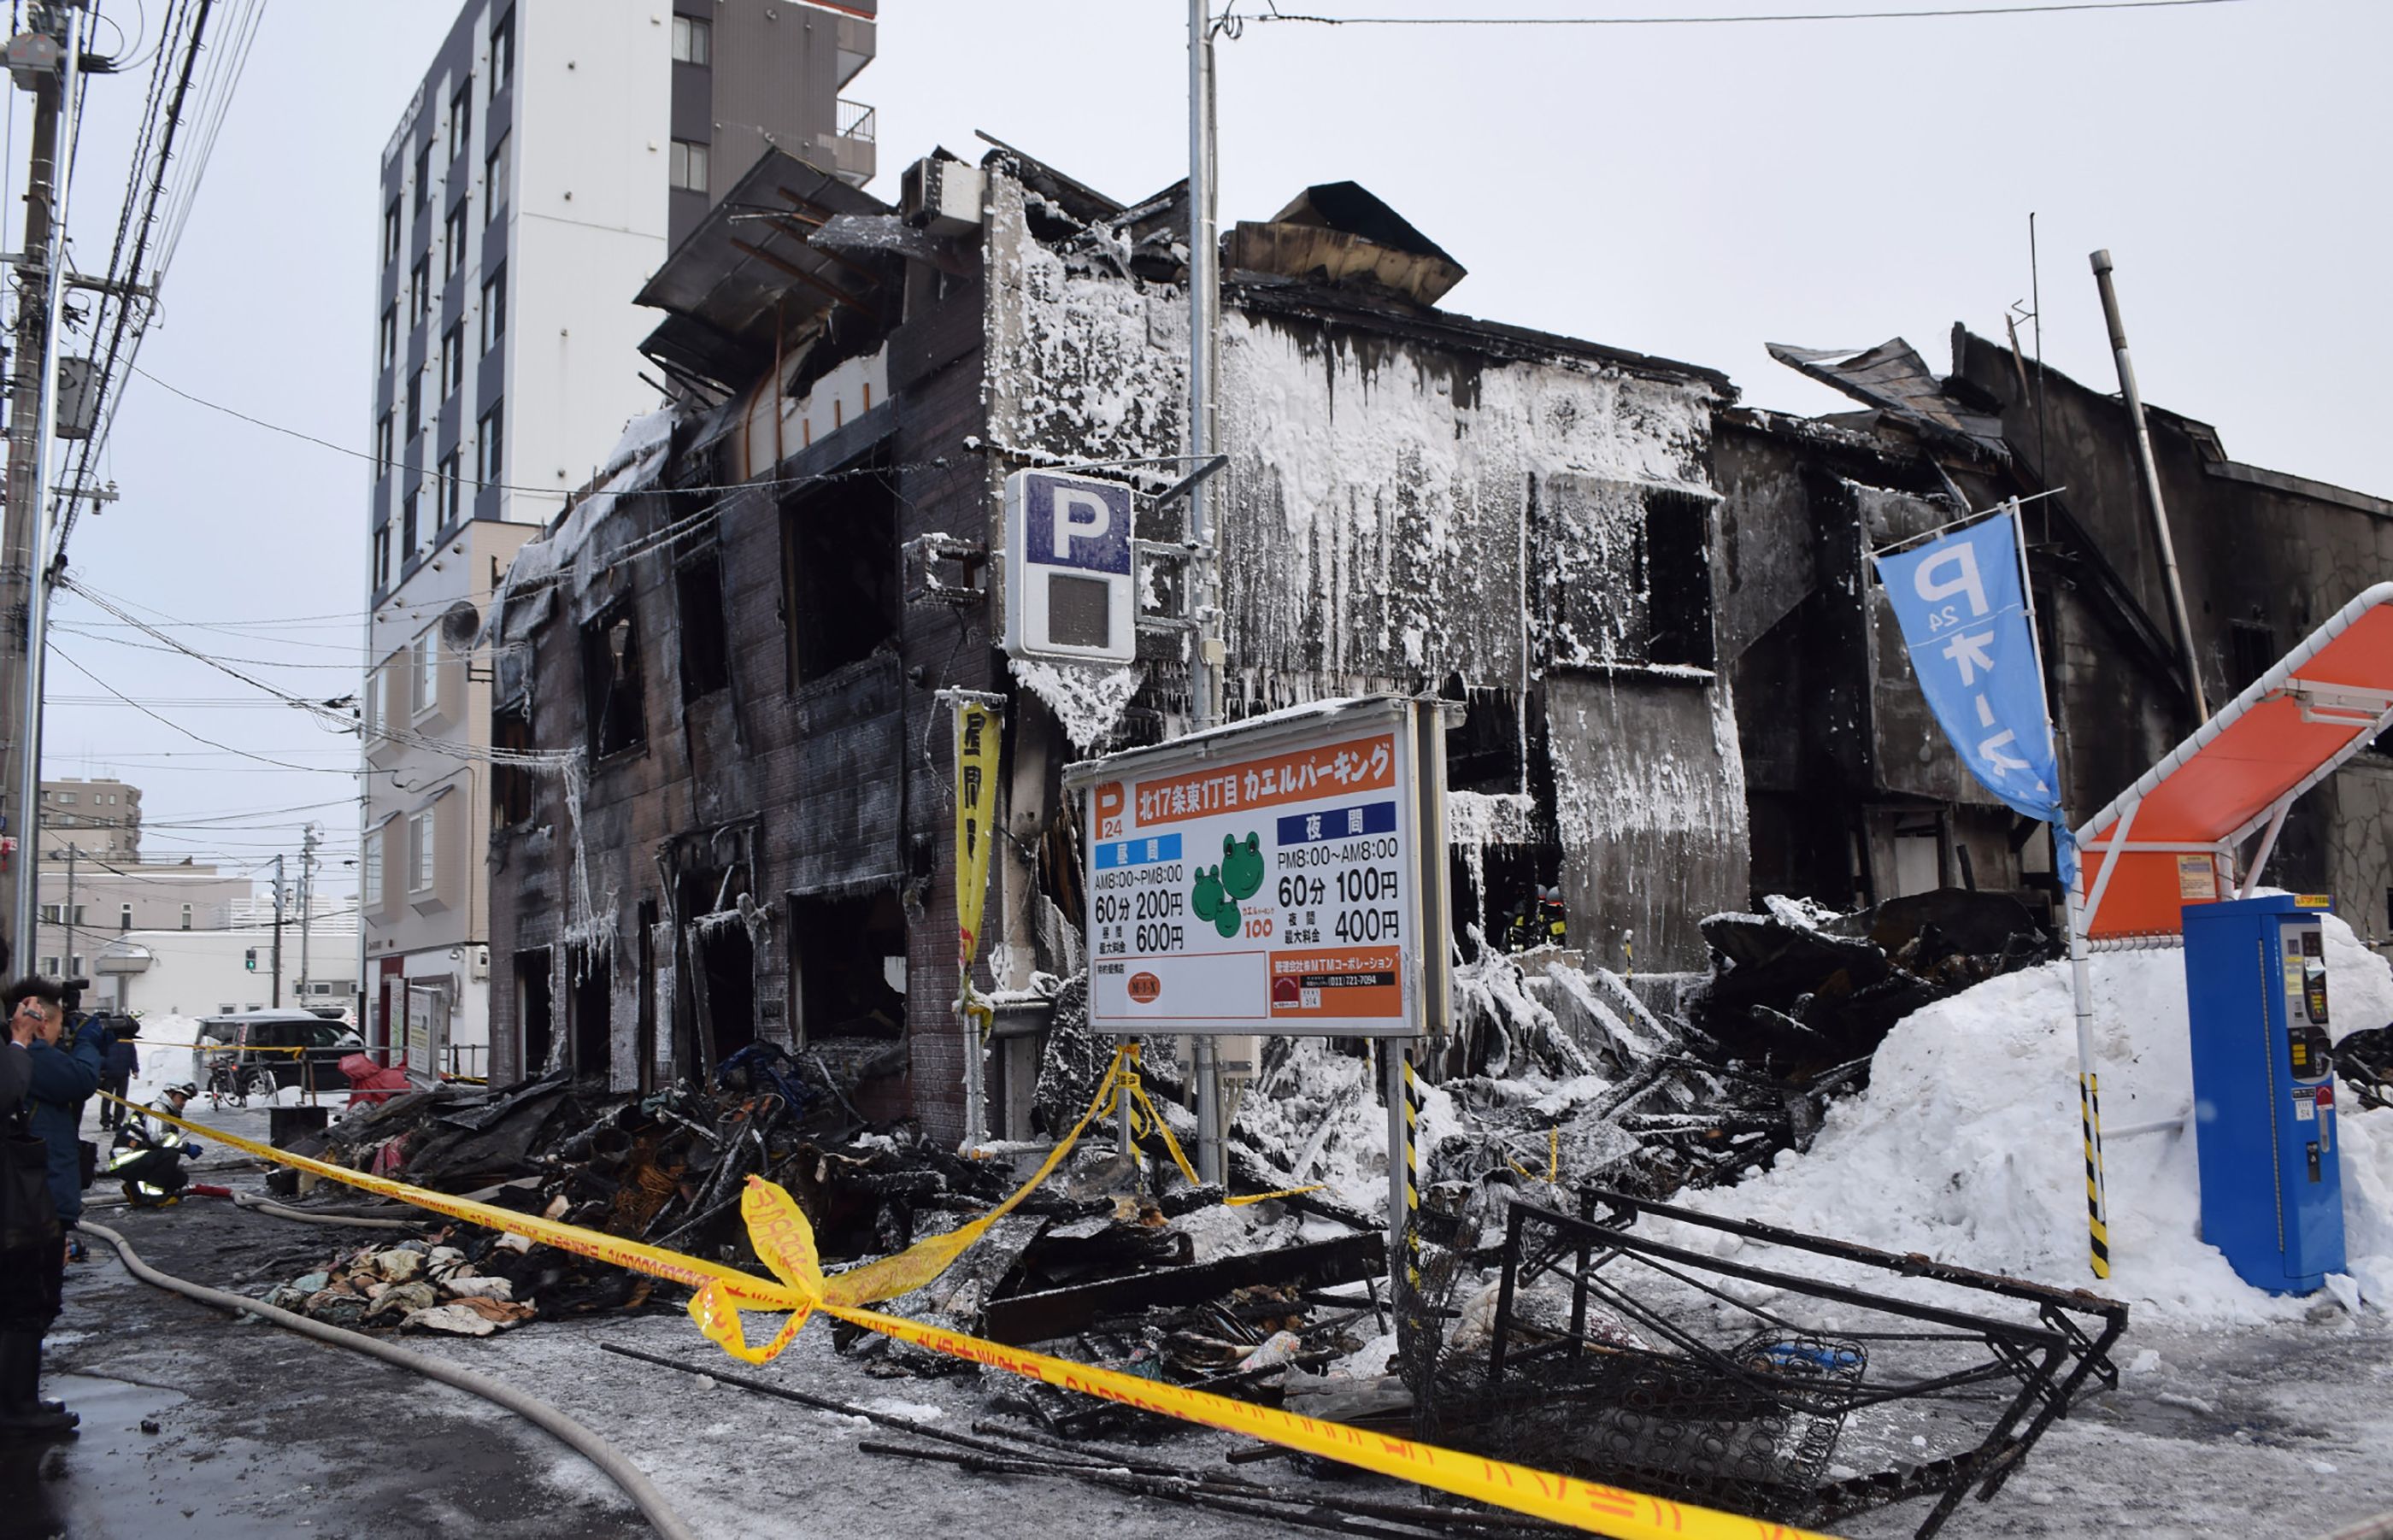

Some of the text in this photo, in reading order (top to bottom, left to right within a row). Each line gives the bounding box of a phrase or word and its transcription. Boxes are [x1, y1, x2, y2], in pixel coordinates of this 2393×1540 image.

[1054, 486, 1109, 559] P
[1139, 742, 1390, 821] 北17条東1丁目 カエルパーキング
[1095, 780, 1125, 841] P 24
[1278, 867, 1398, 908] 60分 100円
[1095, 889, 1183, 924] 60分 200円
[1136, 922, 1184, 953] 600円
[1244, 918, 1273, 938] 100
[1285, 928, 1320, 945] 最大料金
[1335, 908, 1400, 943] 400円
